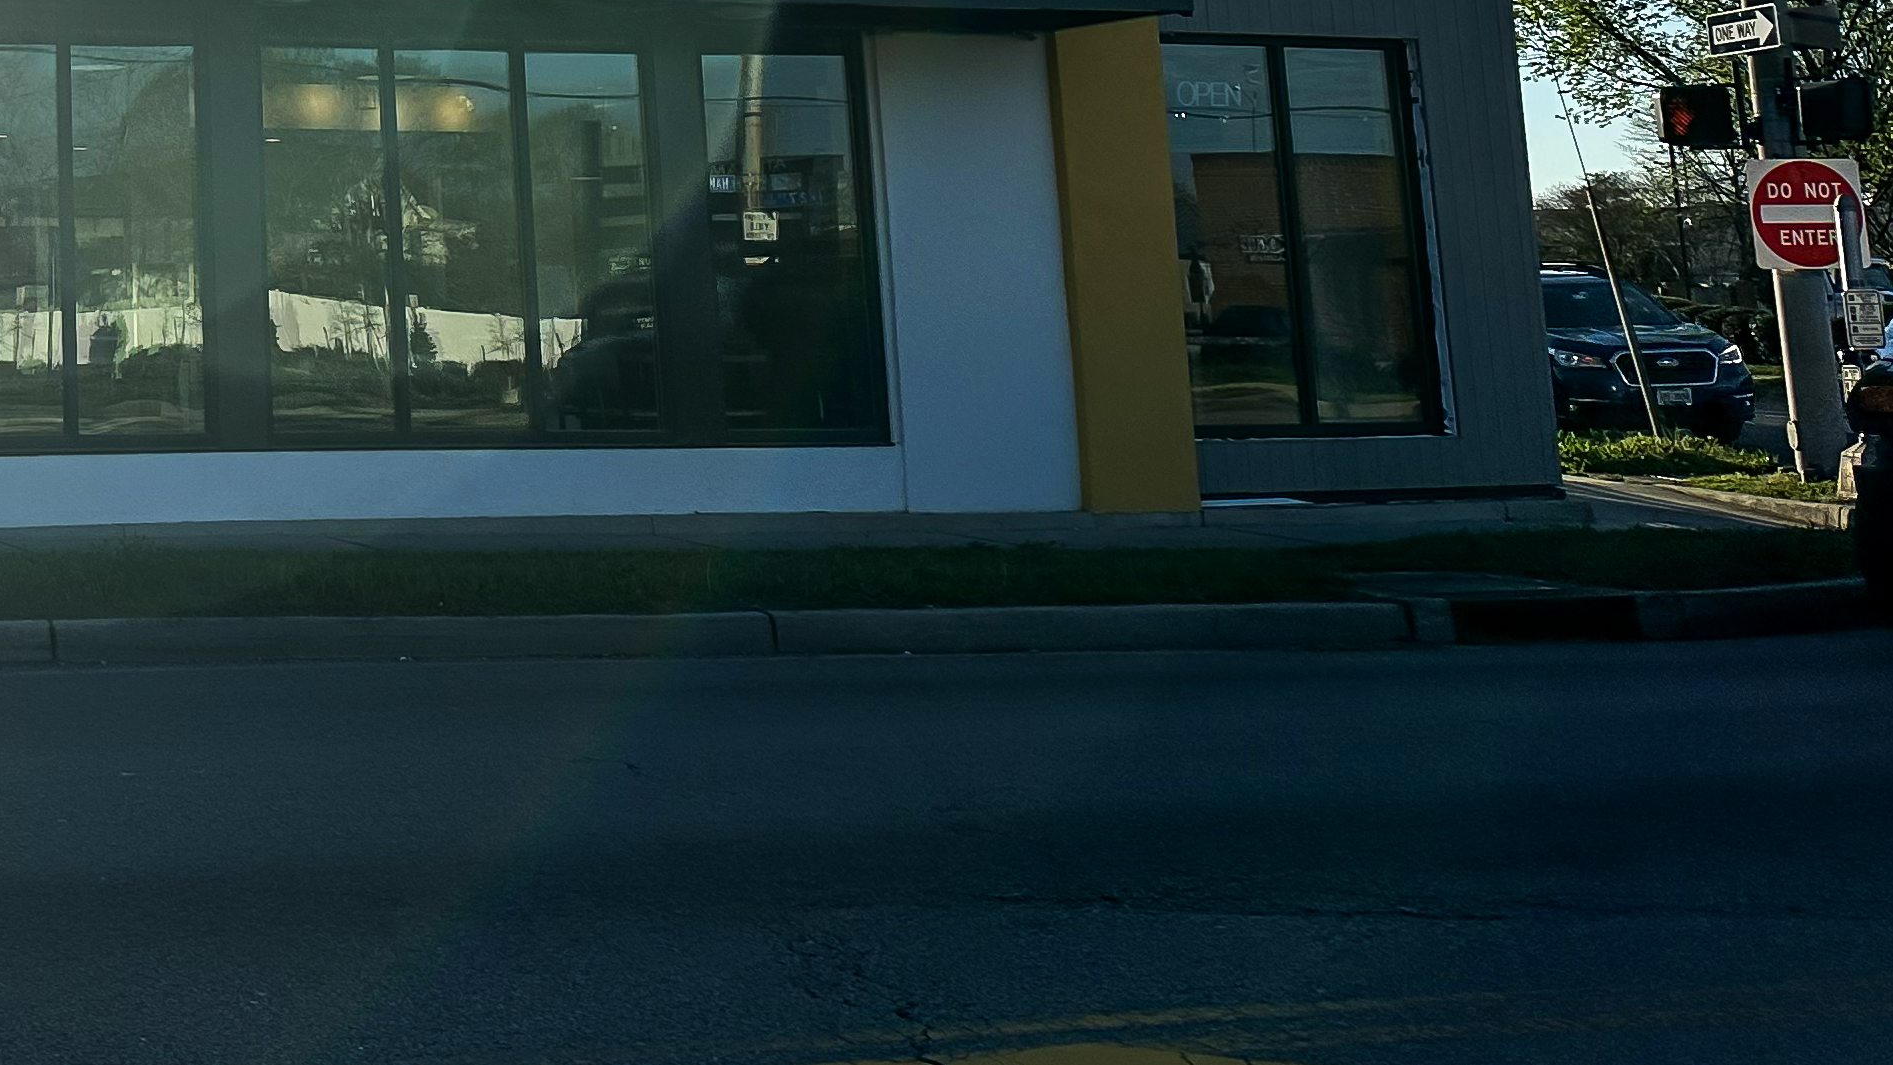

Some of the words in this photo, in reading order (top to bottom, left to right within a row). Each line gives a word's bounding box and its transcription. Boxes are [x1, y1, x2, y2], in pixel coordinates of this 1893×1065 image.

[1715, 24, 1736, 42] ONE
[1736, 20, 1757, 38] WAY
[1177, 80, 1242, 107] OPEN
[1767, 182, 1792, 199] DO
[1804, 182, 1842, 199] NOT
